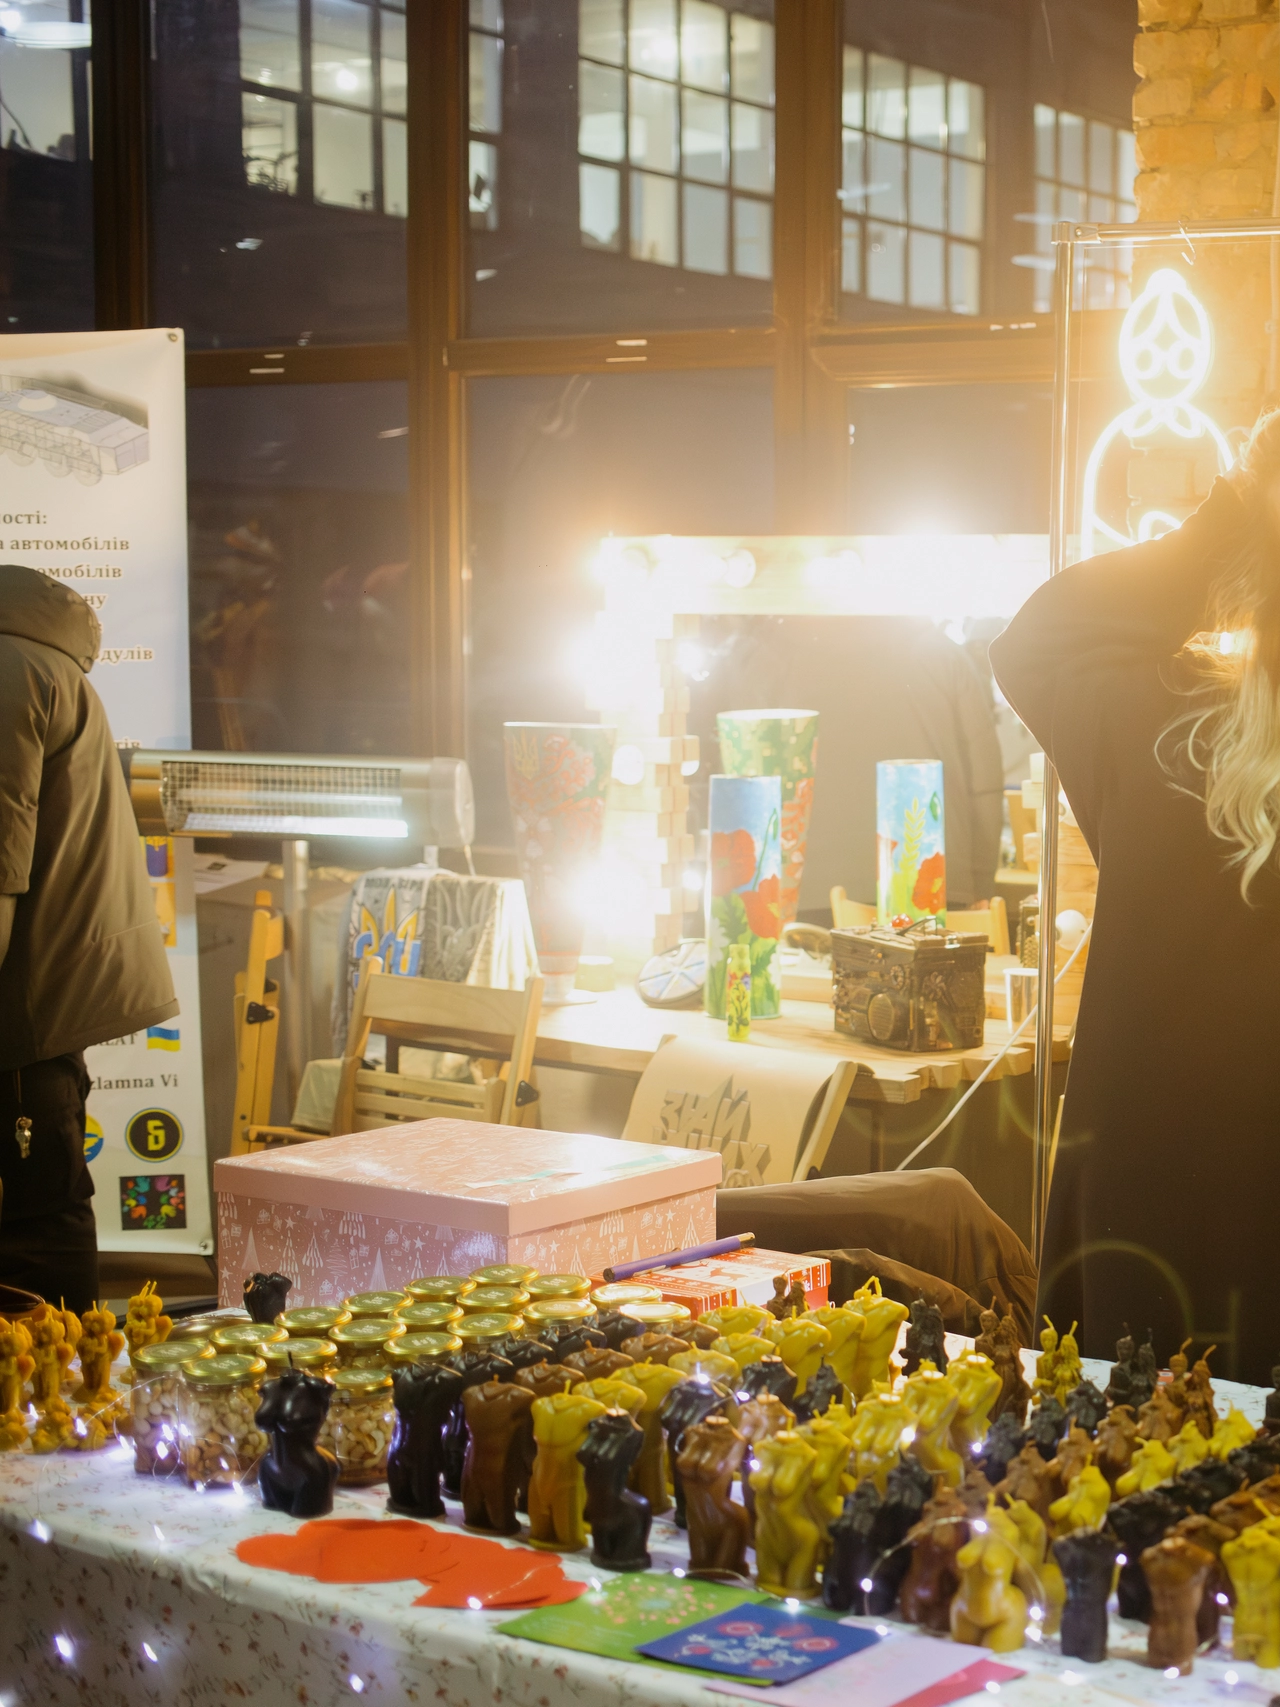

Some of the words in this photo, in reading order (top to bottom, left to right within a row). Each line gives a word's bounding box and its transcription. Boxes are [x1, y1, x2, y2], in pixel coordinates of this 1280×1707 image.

[0, 510, 48, 525] ості:
[10, 536, 130, 551] автомобілів
[41, 564, 123, 578] мобілів
[99, 646, 154, 664] дулів
[90, 1076, 154, 1091] zlamna
[160, 1073, 179, 1088] Vi
